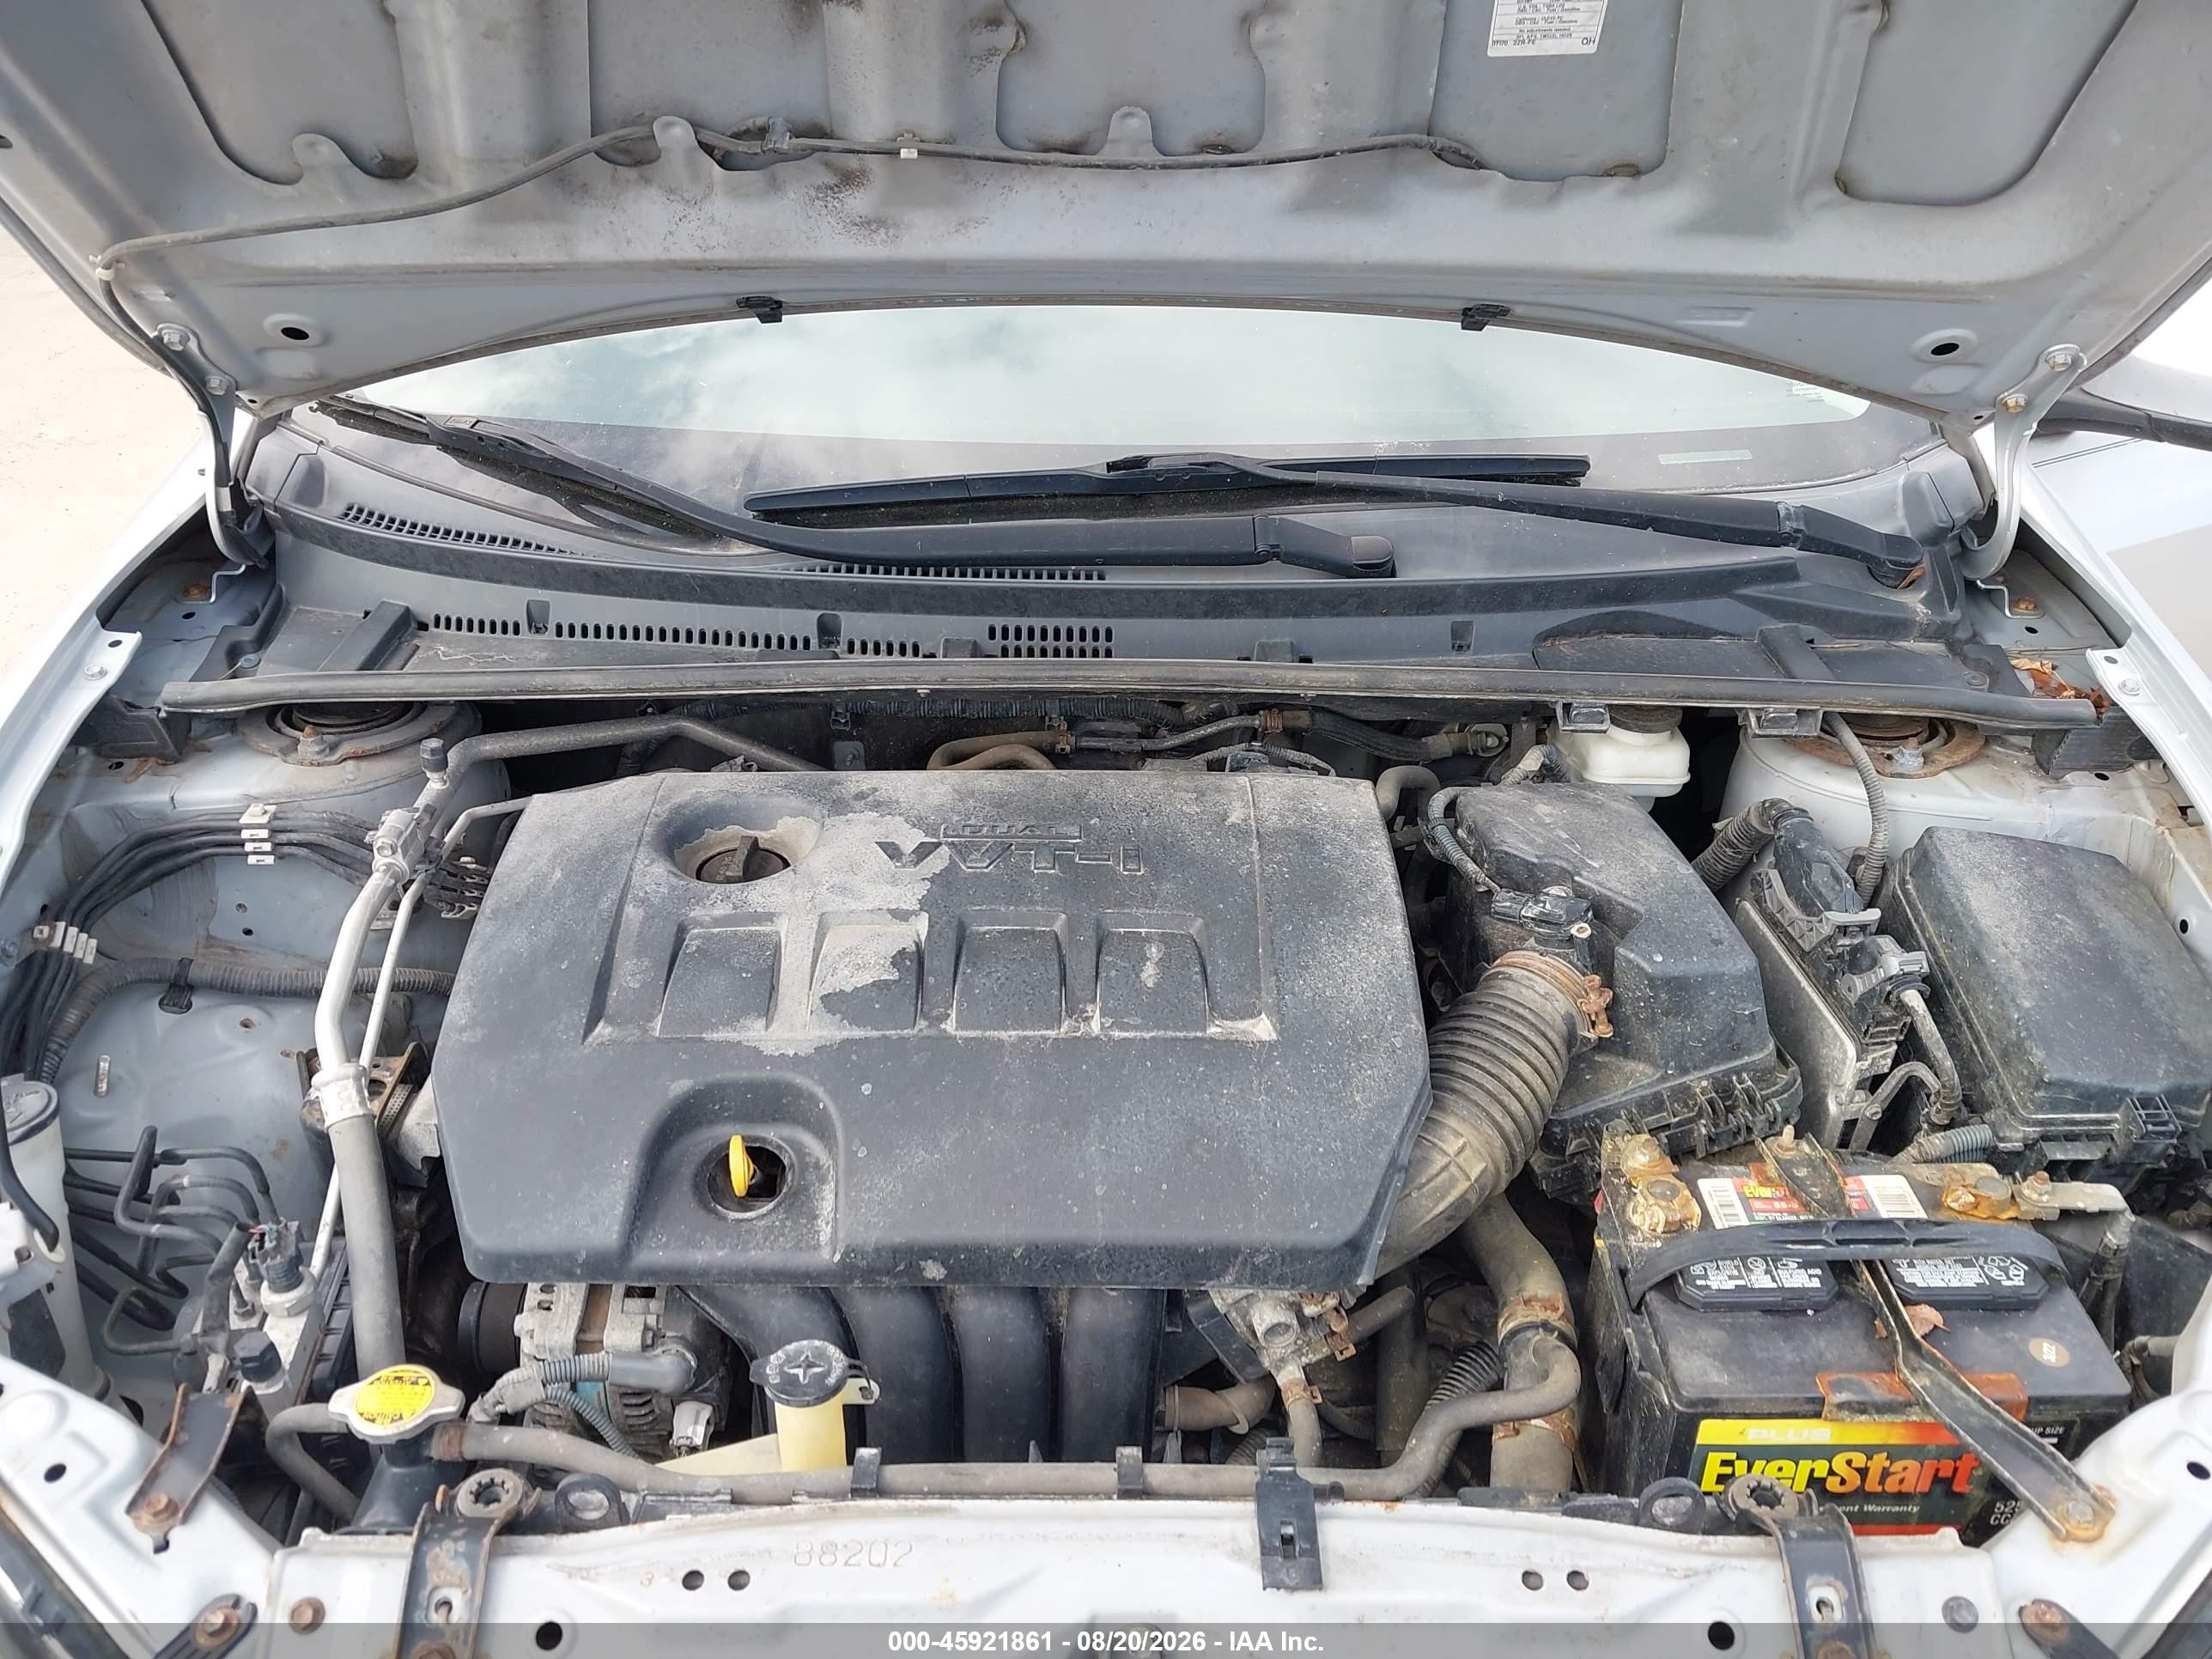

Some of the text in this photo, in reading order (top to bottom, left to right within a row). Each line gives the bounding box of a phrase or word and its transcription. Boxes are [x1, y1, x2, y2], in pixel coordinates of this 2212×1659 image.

[1701, 1450, 1980, 1494] EverStart
[1863, 1504, 1919, 1514] Warranty
[793, 1540, 913, 1567] 88202
